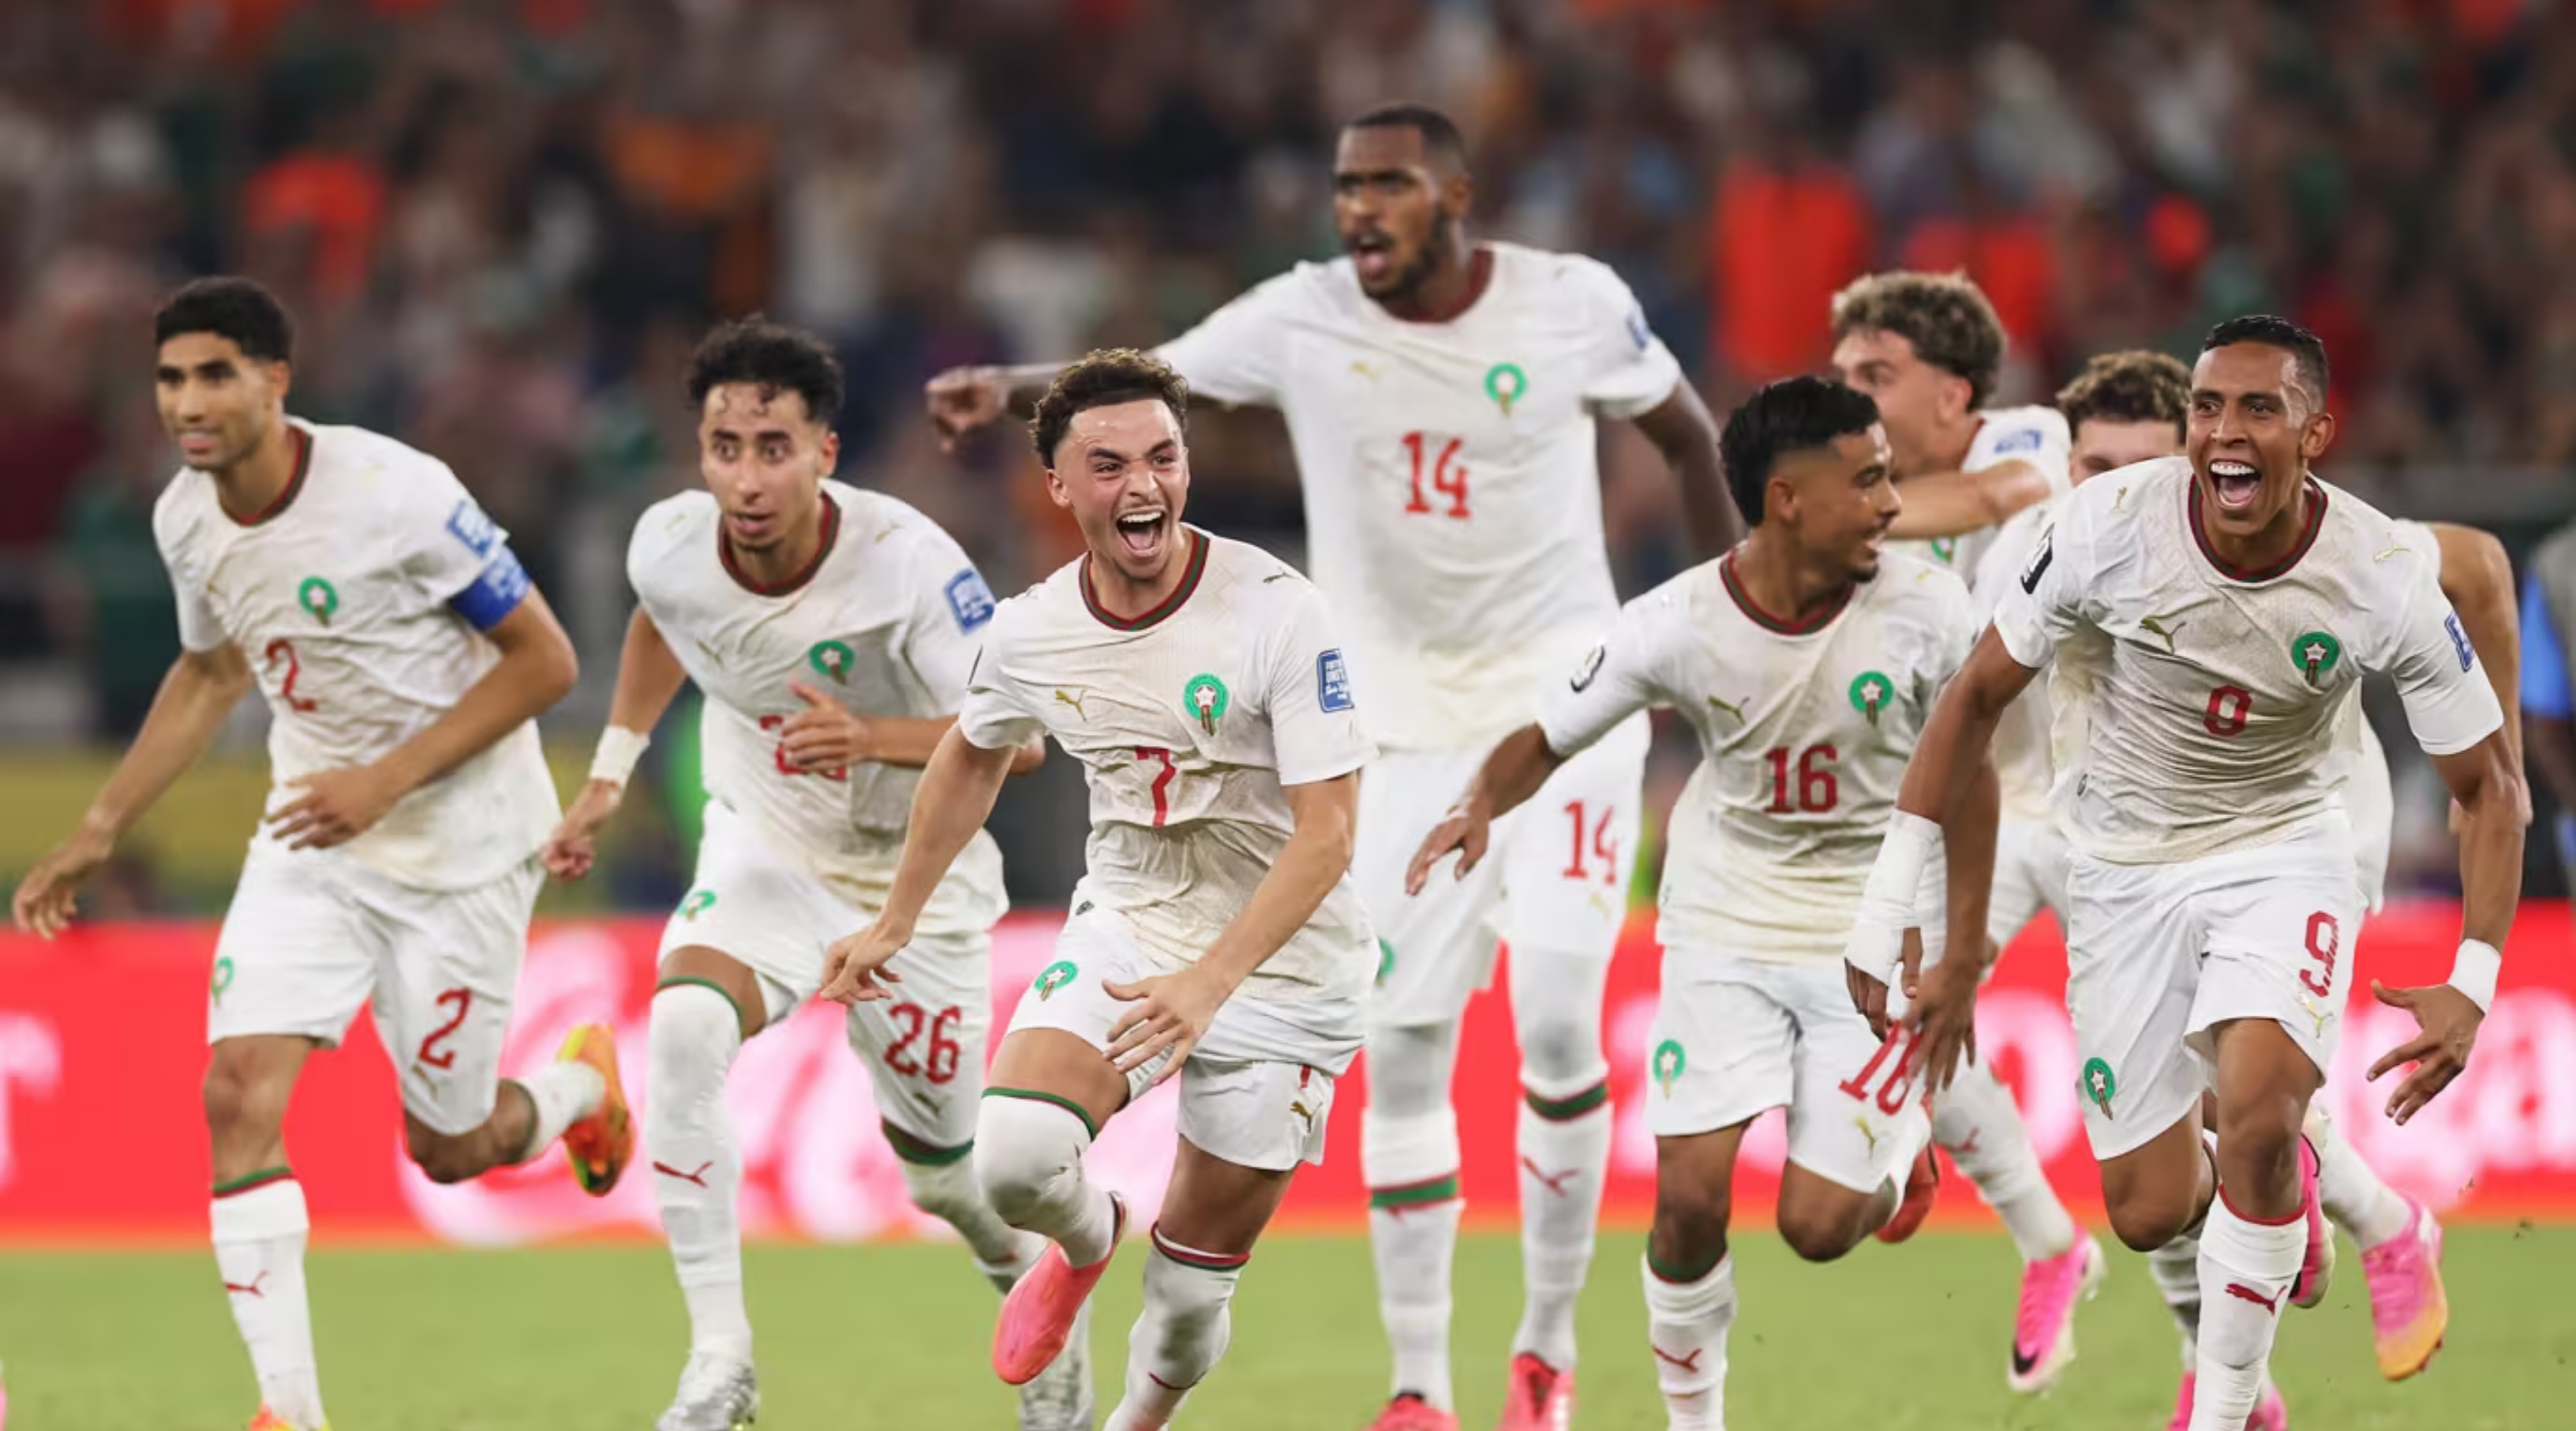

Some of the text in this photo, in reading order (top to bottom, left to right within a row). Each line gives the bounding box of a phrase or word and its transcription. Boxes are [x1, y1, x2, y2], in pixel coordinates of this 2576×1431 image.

[1400, 431, 1472, 520] 14
[264, 638, 319, 713] 2
[1134, 745, 1178, 829] 7
[1763, 744, 1839, 813] 16
[1562, 799, 1618, 886] 14
[2299, 910, 2339, 998] 9
[417, 987, 473, 1070] 2
[883, 1001, 962, 1085] 26
